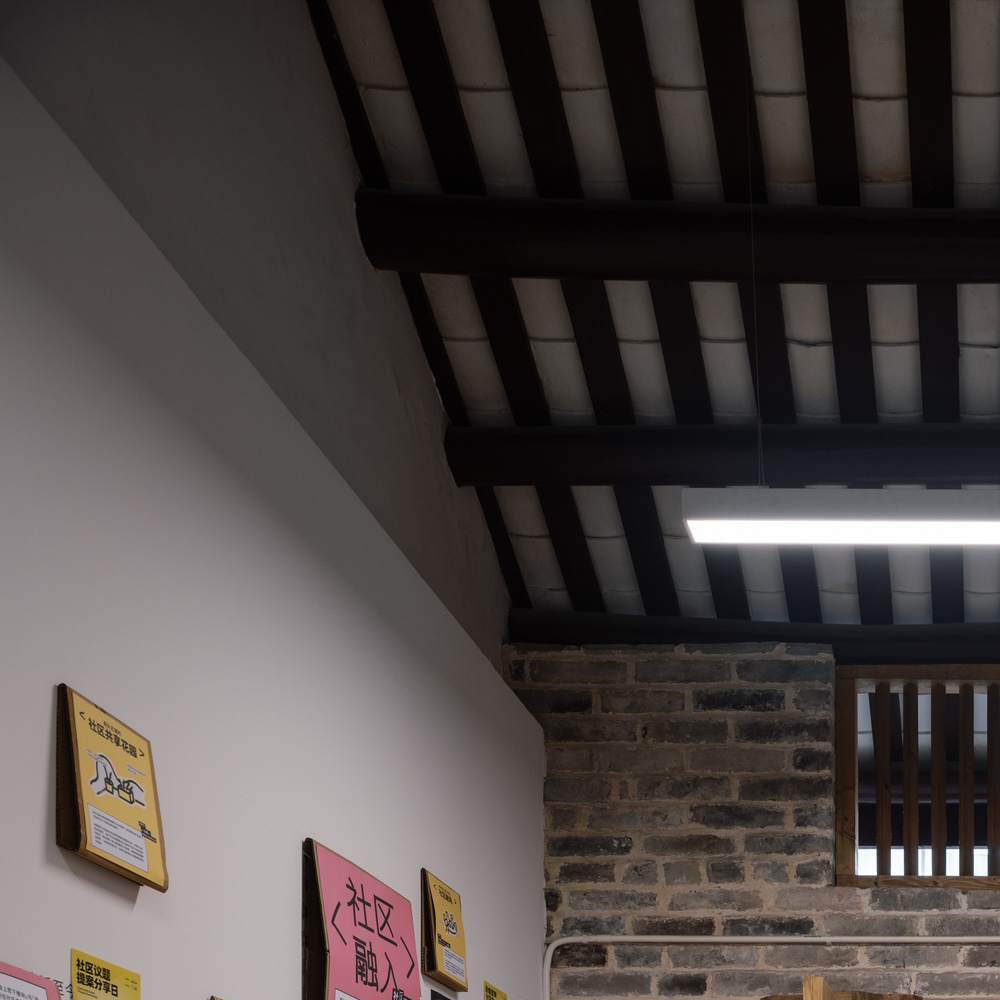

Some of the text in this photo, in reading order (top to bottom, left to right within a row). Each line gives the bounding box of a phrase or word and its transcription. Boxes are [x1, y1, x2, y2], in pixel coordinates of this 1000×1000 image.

[88, 717, 138, 759] 社区共享花园
[345, 876, 398, 947] 社区
[76, 957, 111, 982] 社区议题
[76, 971, 119, 997] 提案分享日
[352, 935, 398, 993] 融入
